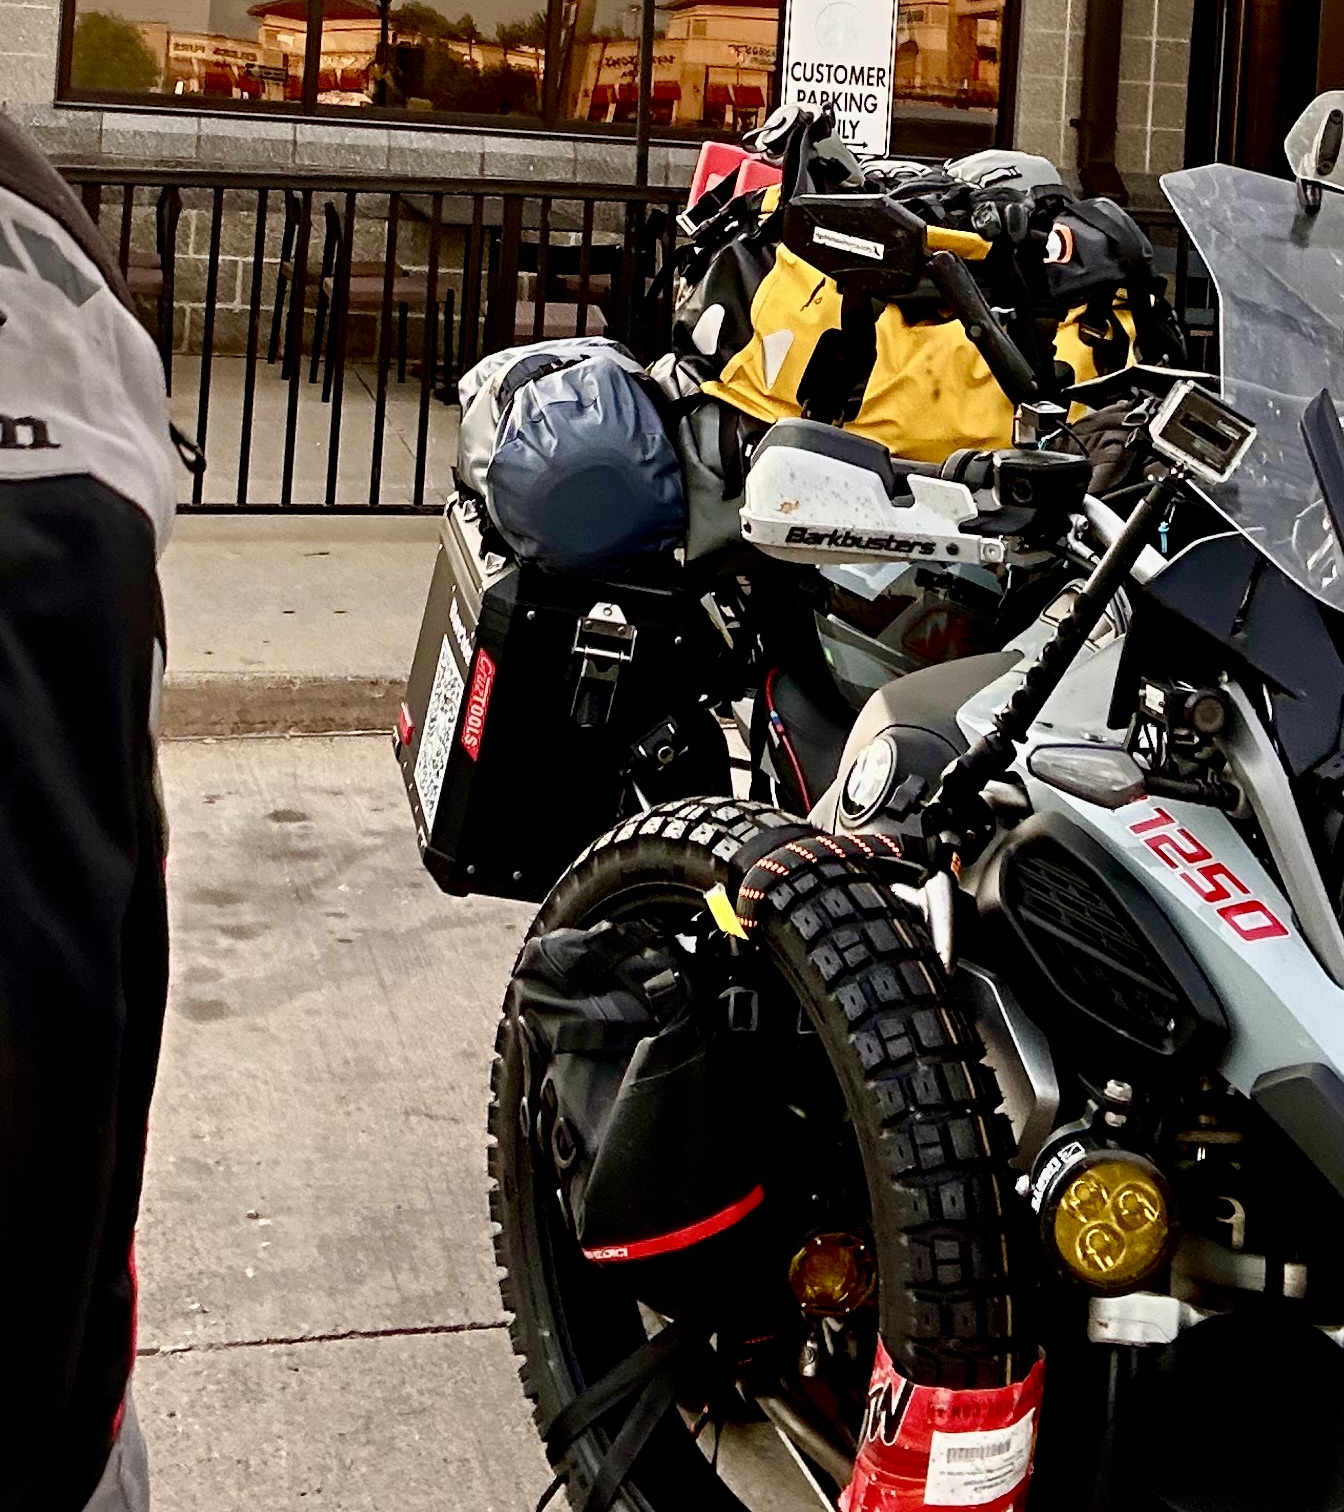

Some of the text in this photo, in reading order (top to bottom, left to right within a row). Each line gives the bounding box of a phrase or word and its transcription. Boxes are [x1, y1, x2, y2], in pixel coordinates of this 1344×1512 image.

[790, 61, 887, 88] CUSTOMER
[796, 89, 879, 114] PARKING
[784, 526, 937, 556] Barkbusters
[1126, 806, 1291, 942] 1250
